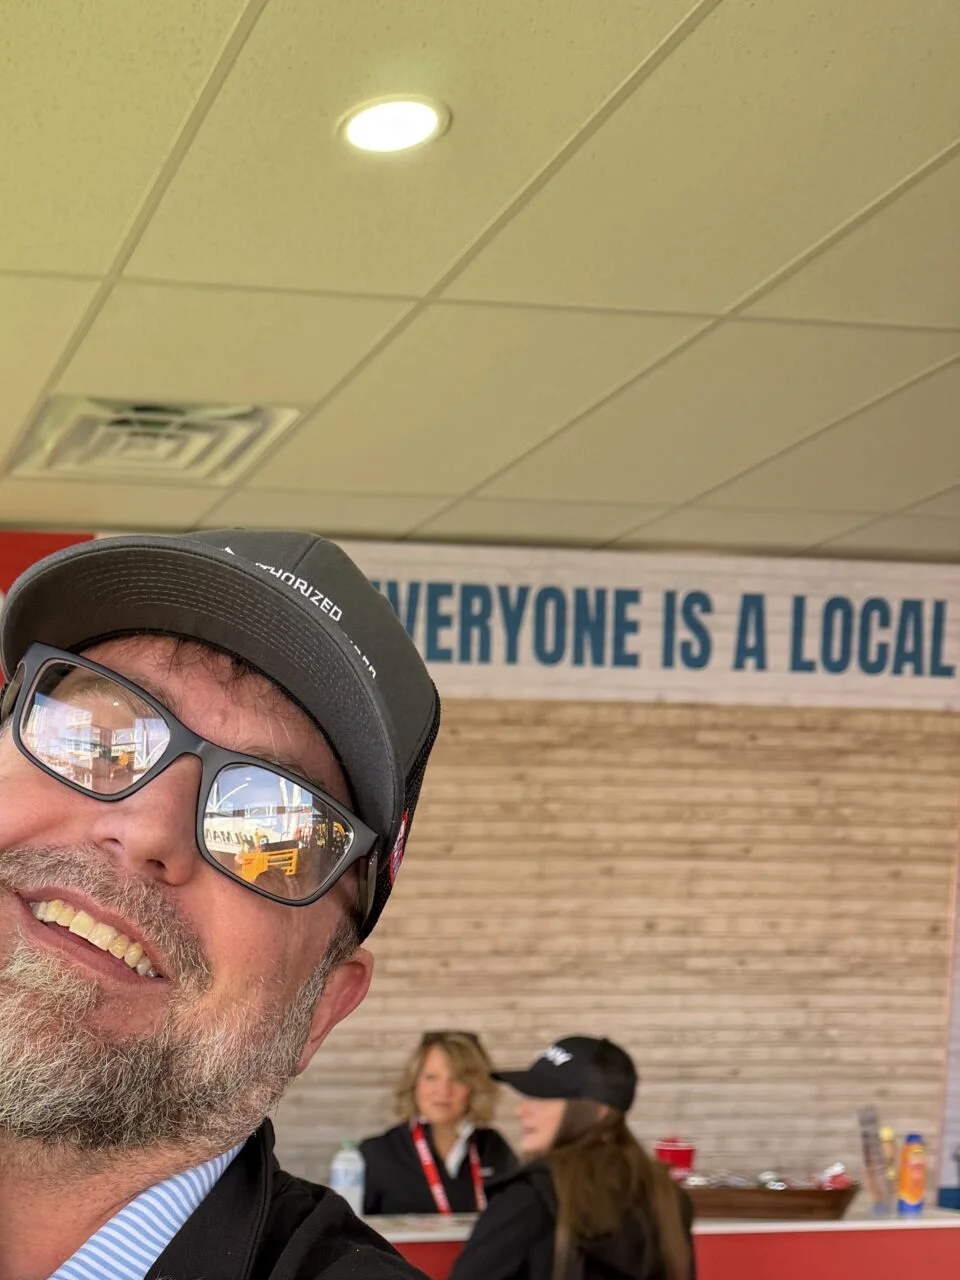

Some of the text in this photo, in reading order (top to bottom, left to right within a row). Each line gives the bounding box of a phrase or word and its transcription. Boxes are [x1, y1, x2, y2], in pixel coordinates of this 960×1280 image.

[255, 562, 343, 622] HORIZED
[369, 580, 643, 668] VERYONE
[661, 589, 713, 671] IS
[732, 593, 767, 672] A
[790, 595, 956, 678] LOCAL
